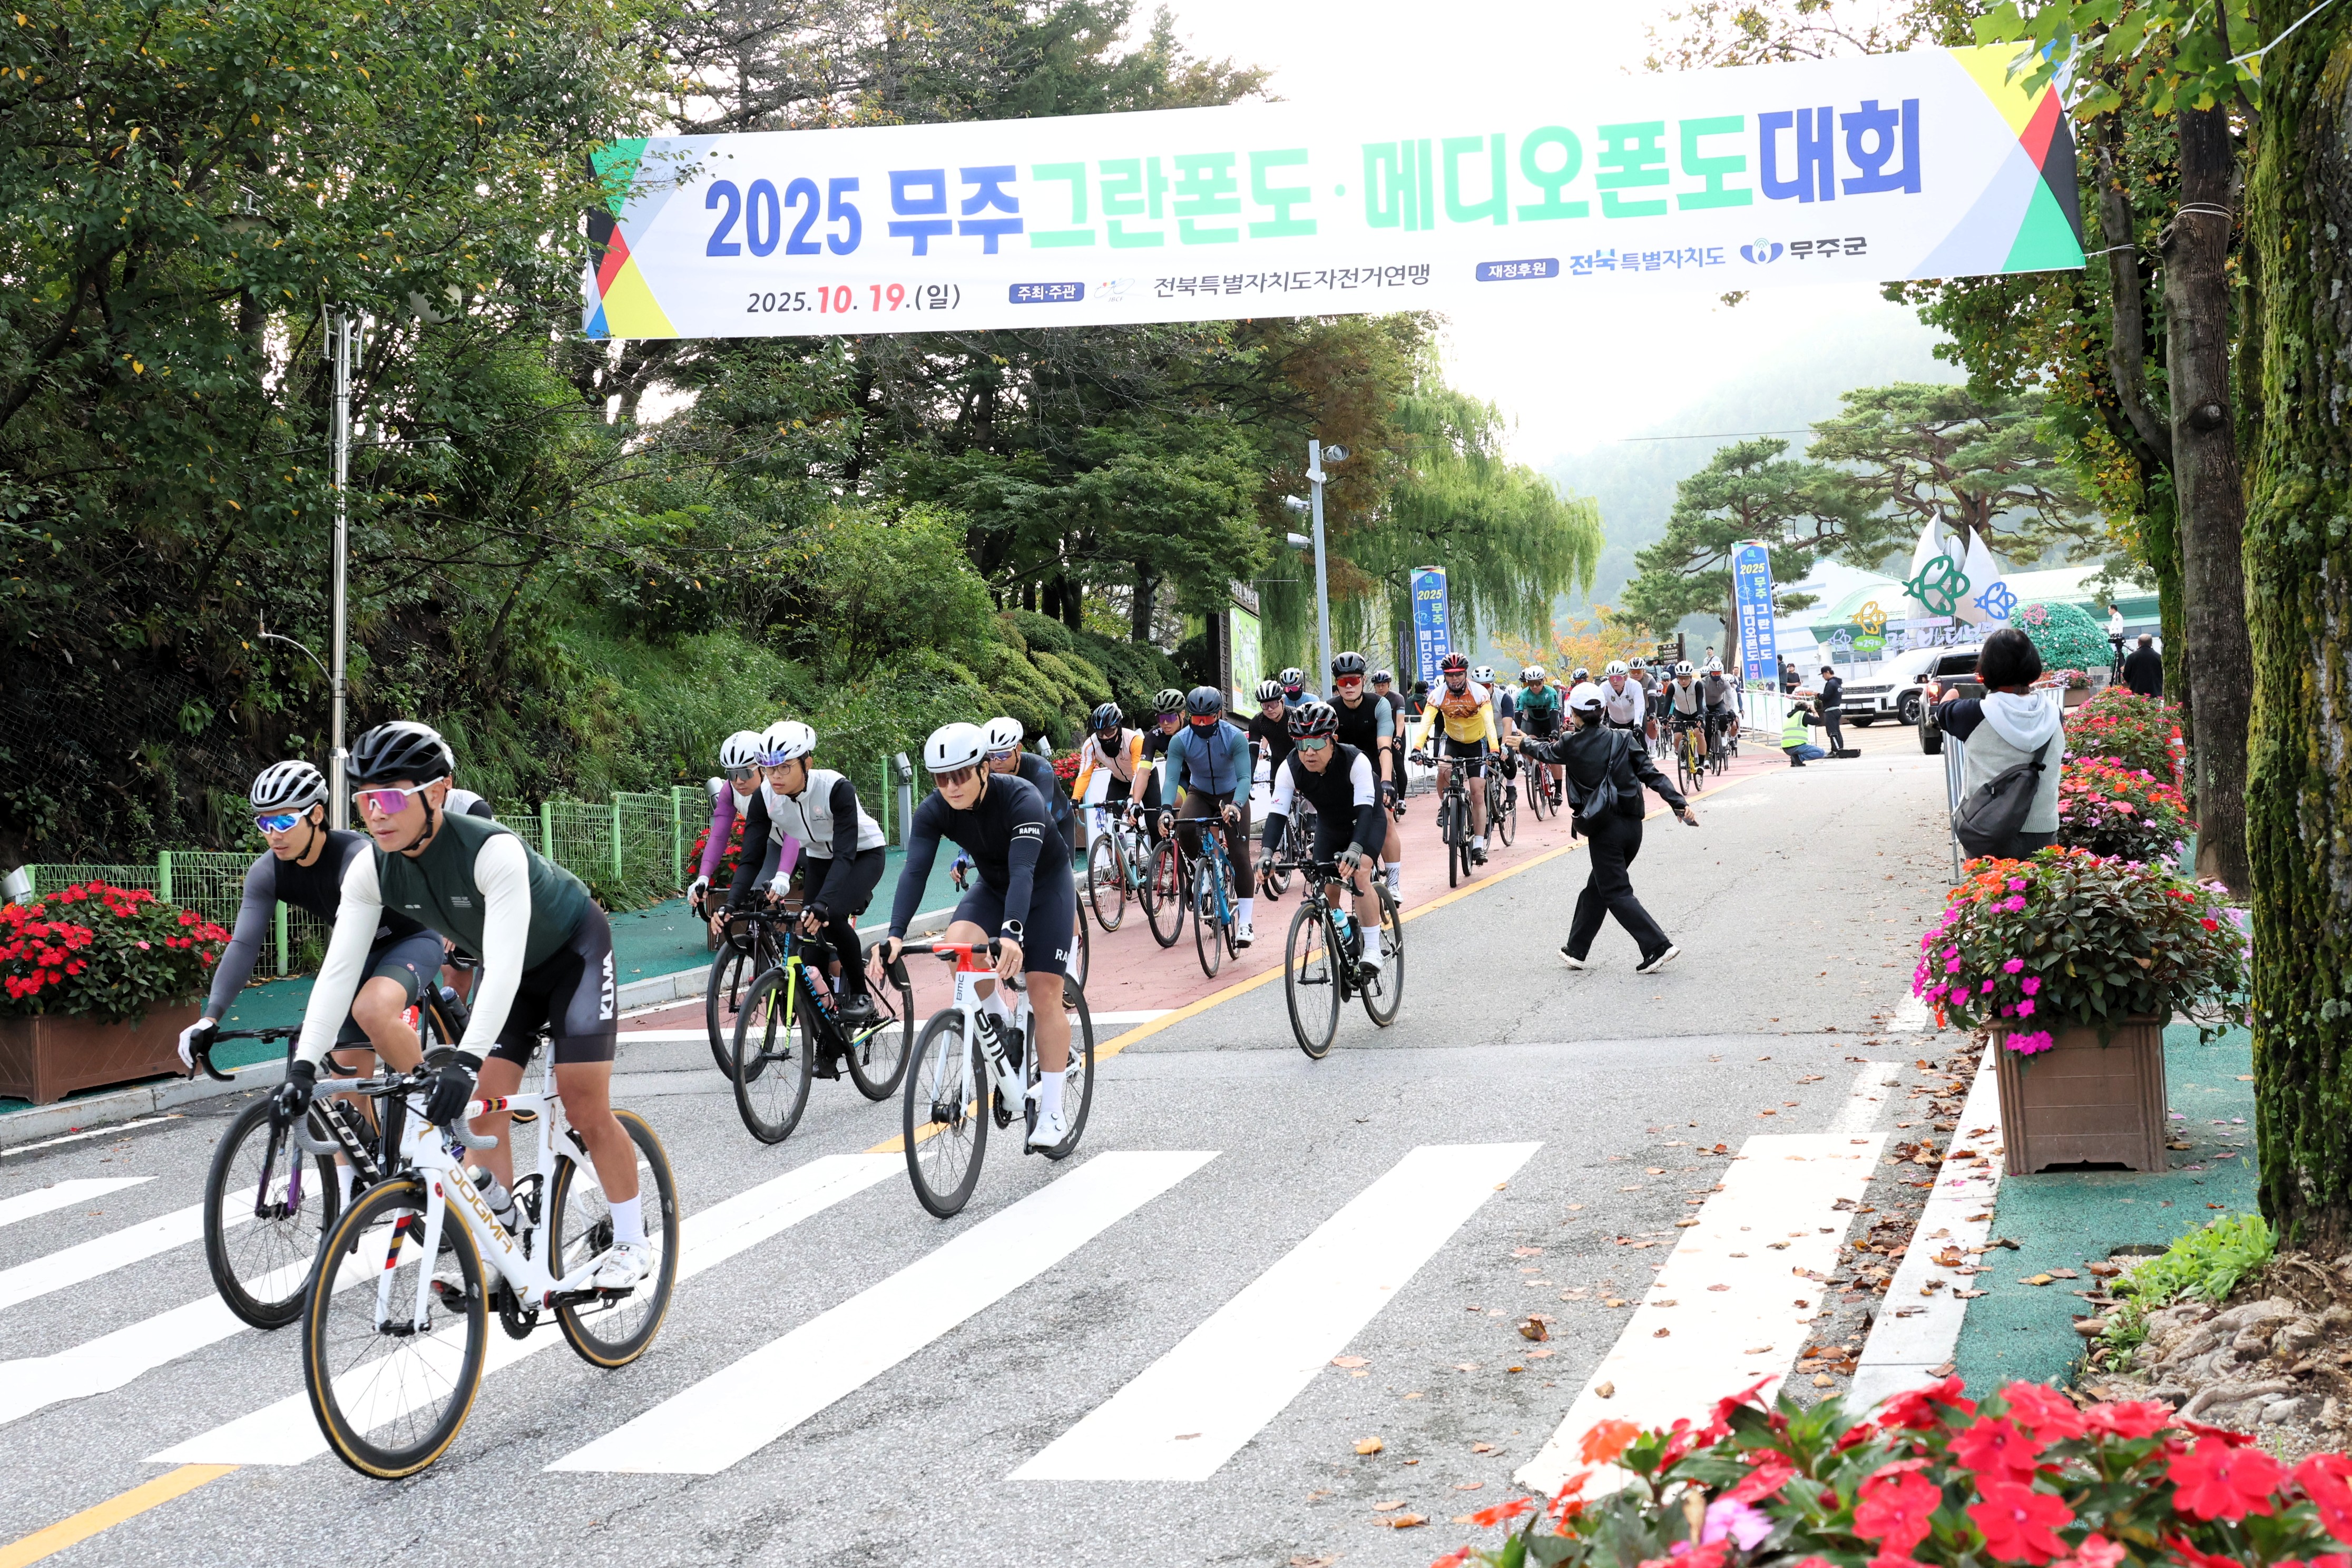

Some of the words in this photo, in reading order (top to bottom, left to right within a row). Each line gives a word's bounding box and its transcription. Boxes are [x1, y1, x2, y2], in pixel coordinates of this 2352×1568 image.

[706, 178, 861, 257] 2025
[1790, 237, 1867, 260] 무주군
[1487, 261, 1546, 279] 재정후원
[1569, 247, 1726, 276] 전북특별자치도
[1154, 263, 1430, 298] 전북특별자치도자전거연맹
[1017, 284, 1076, 301] 주최·주관
[1740, 563, 1765, 574] 2025
[1418, 589, 1443, 600] 2025
[1754, 576, 1767, 599] 무주
[1432, 603, 1444, 625] 무주
[1743, 604, 1759, 661] 메디오폰도
[1757, 604, 1772, 660] 그란폰도
[1750, 663, 1759, 680] 대회
[1055, 948, 1071, 963] RA
[975, 1008, 1006, 1077] BMC
[316, 1096, 381, 1175] SCOTT
[448, 1165, 513, 1254] DOGMA
